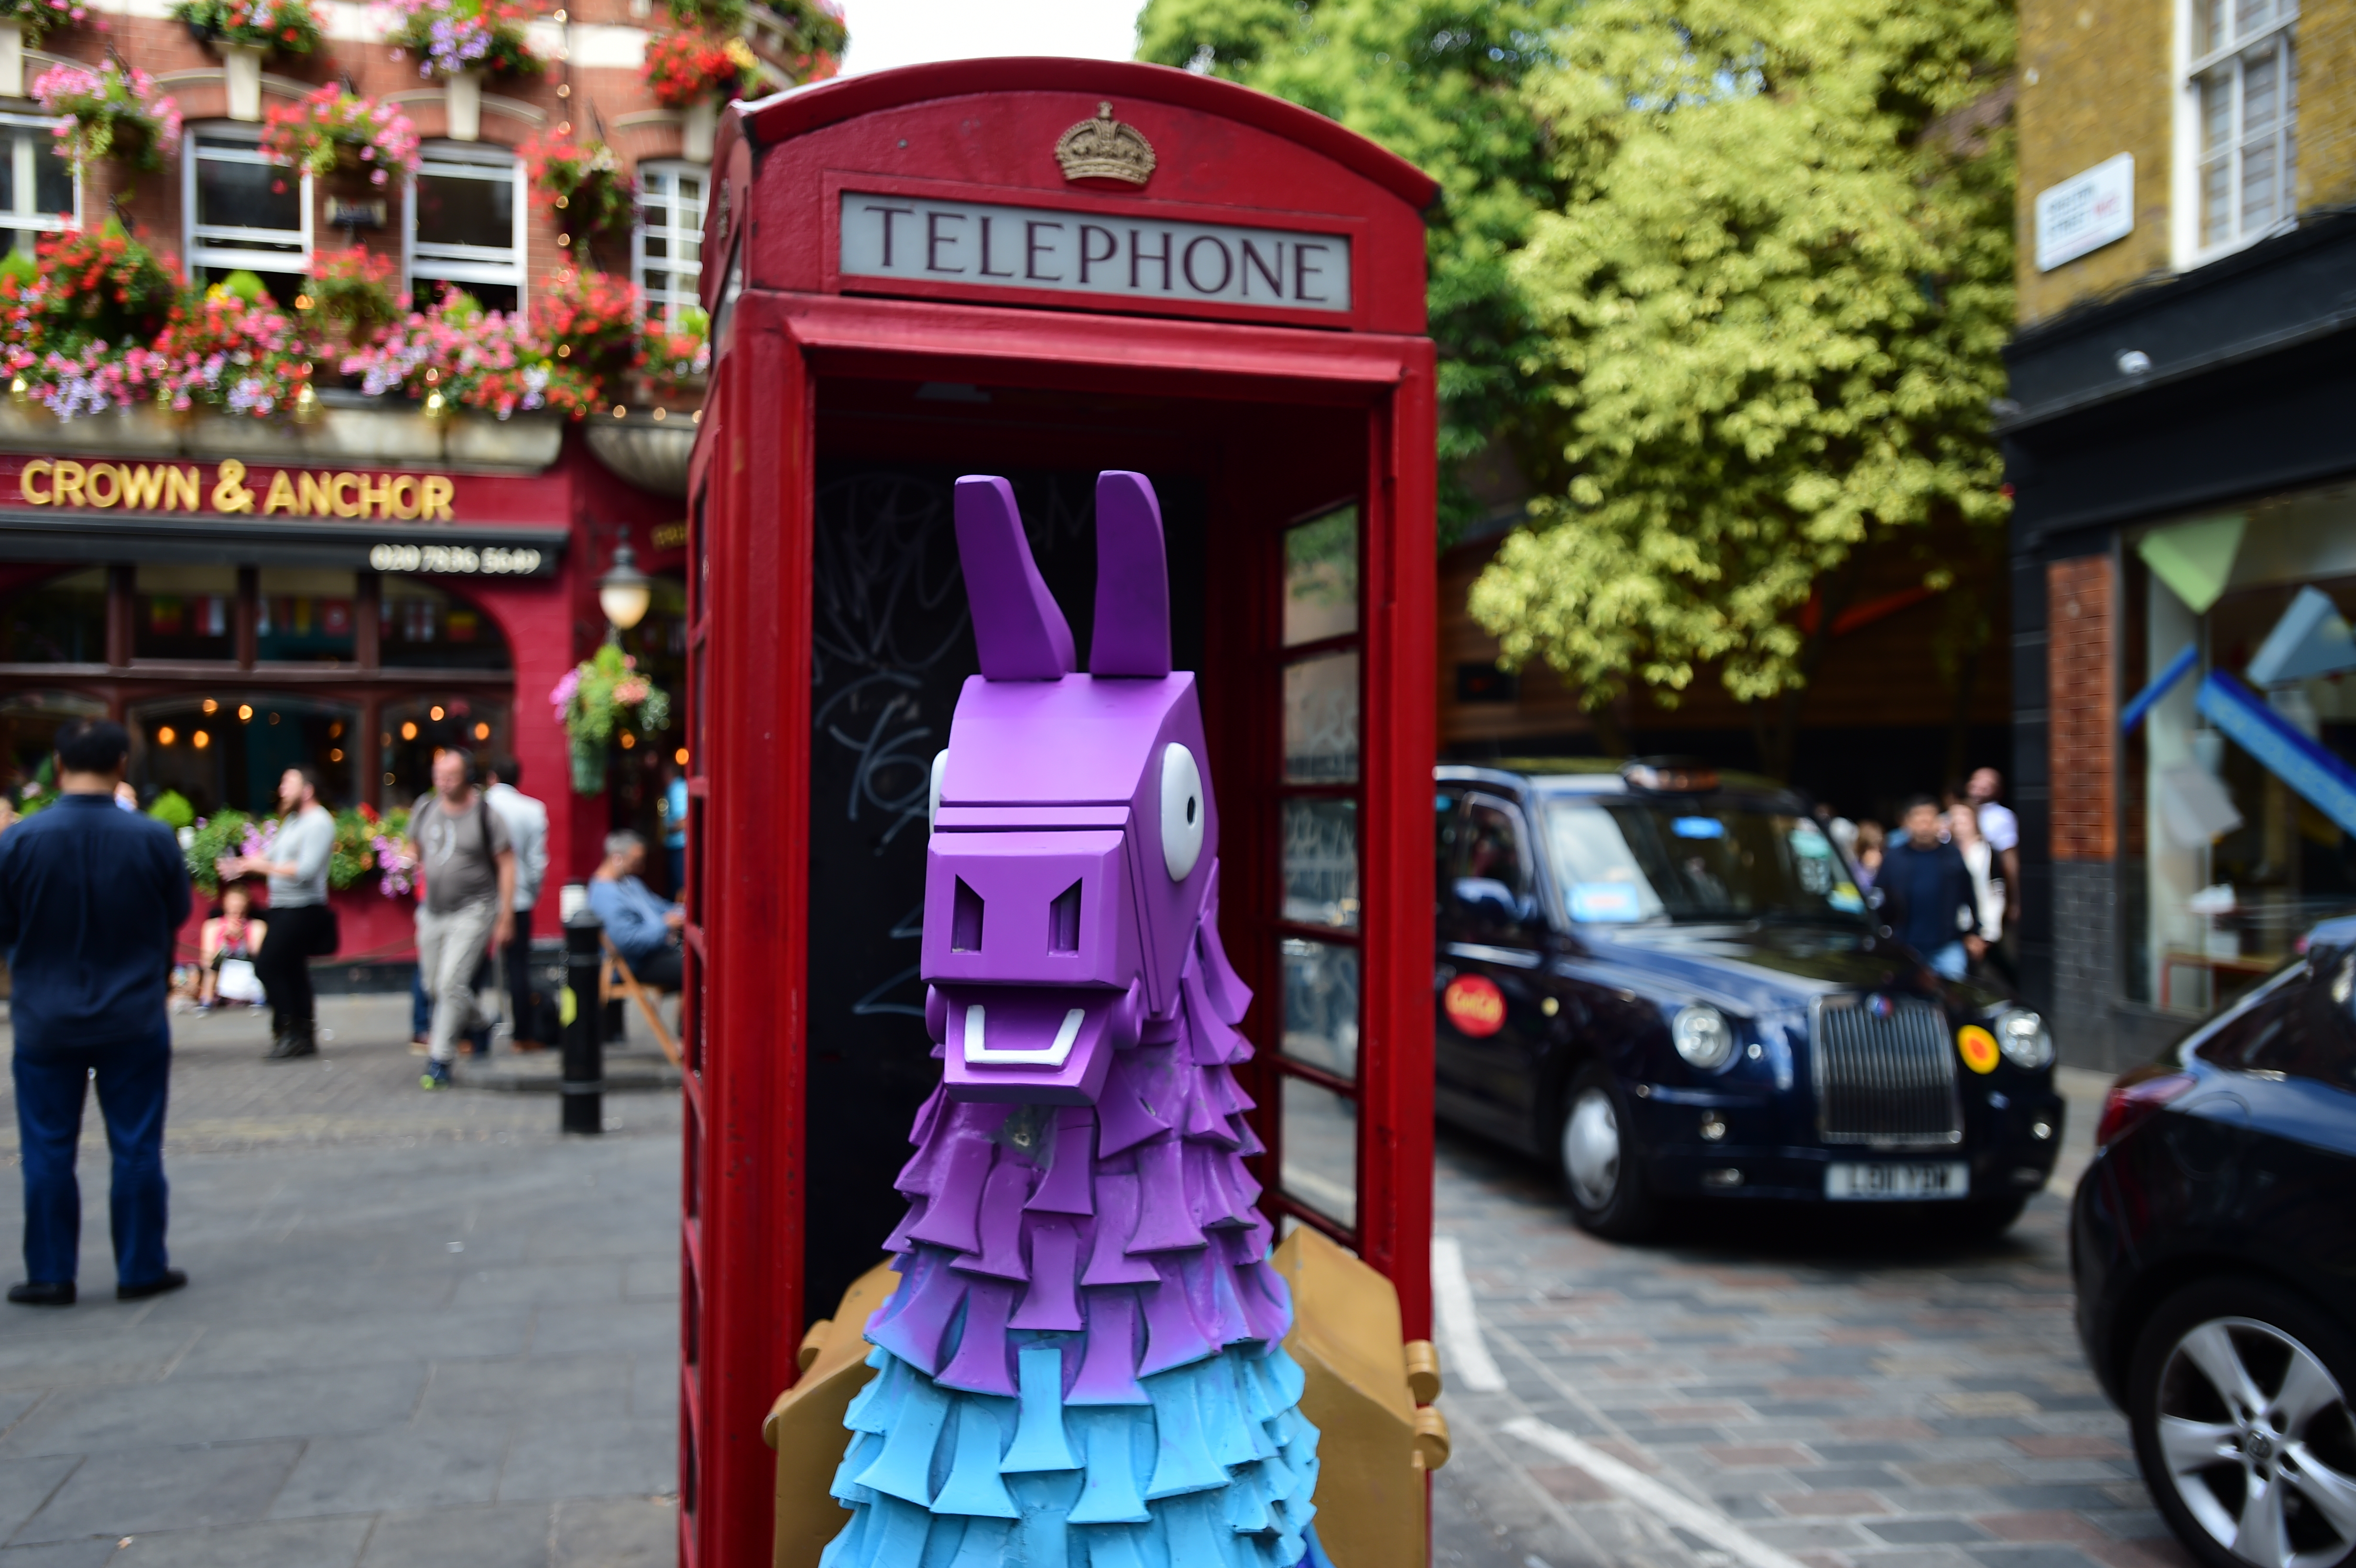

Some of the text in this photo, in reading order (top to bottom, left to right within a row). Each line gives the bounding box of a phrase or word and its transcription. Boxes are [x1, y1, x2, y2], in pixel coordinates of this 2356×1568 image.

[864, 206, 1329, 303] TELEPHONE
[21, 458, 455, 521] CROWN & ANCHOR
[371, 544, 421, 571] 020
